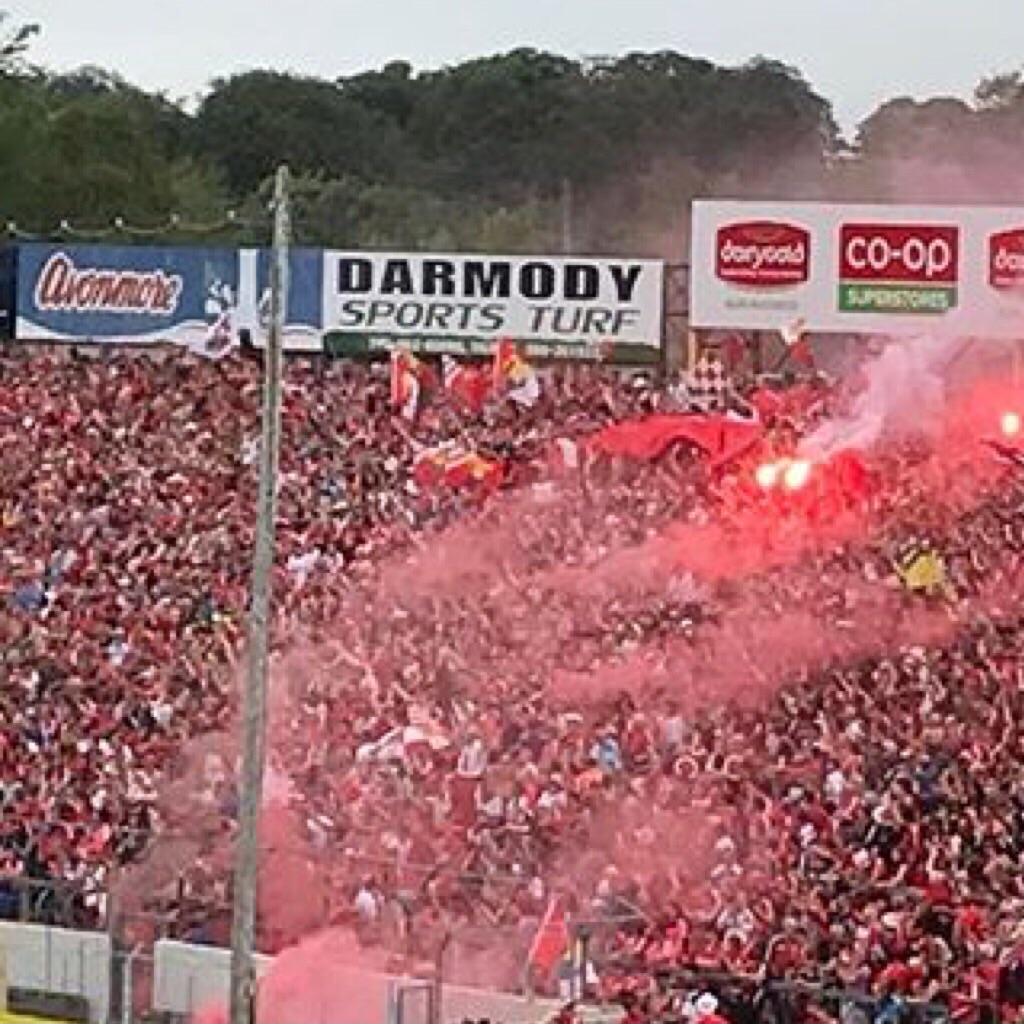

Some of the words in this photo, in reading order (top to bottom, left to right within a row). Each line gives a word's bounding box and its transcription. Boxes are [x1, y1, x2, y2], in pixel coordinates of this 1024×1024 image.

[337, 258, 642, 301] DARMODY
[338, 300, 506, 331] SPORTS
[528, 305, 642, 334] TURF
